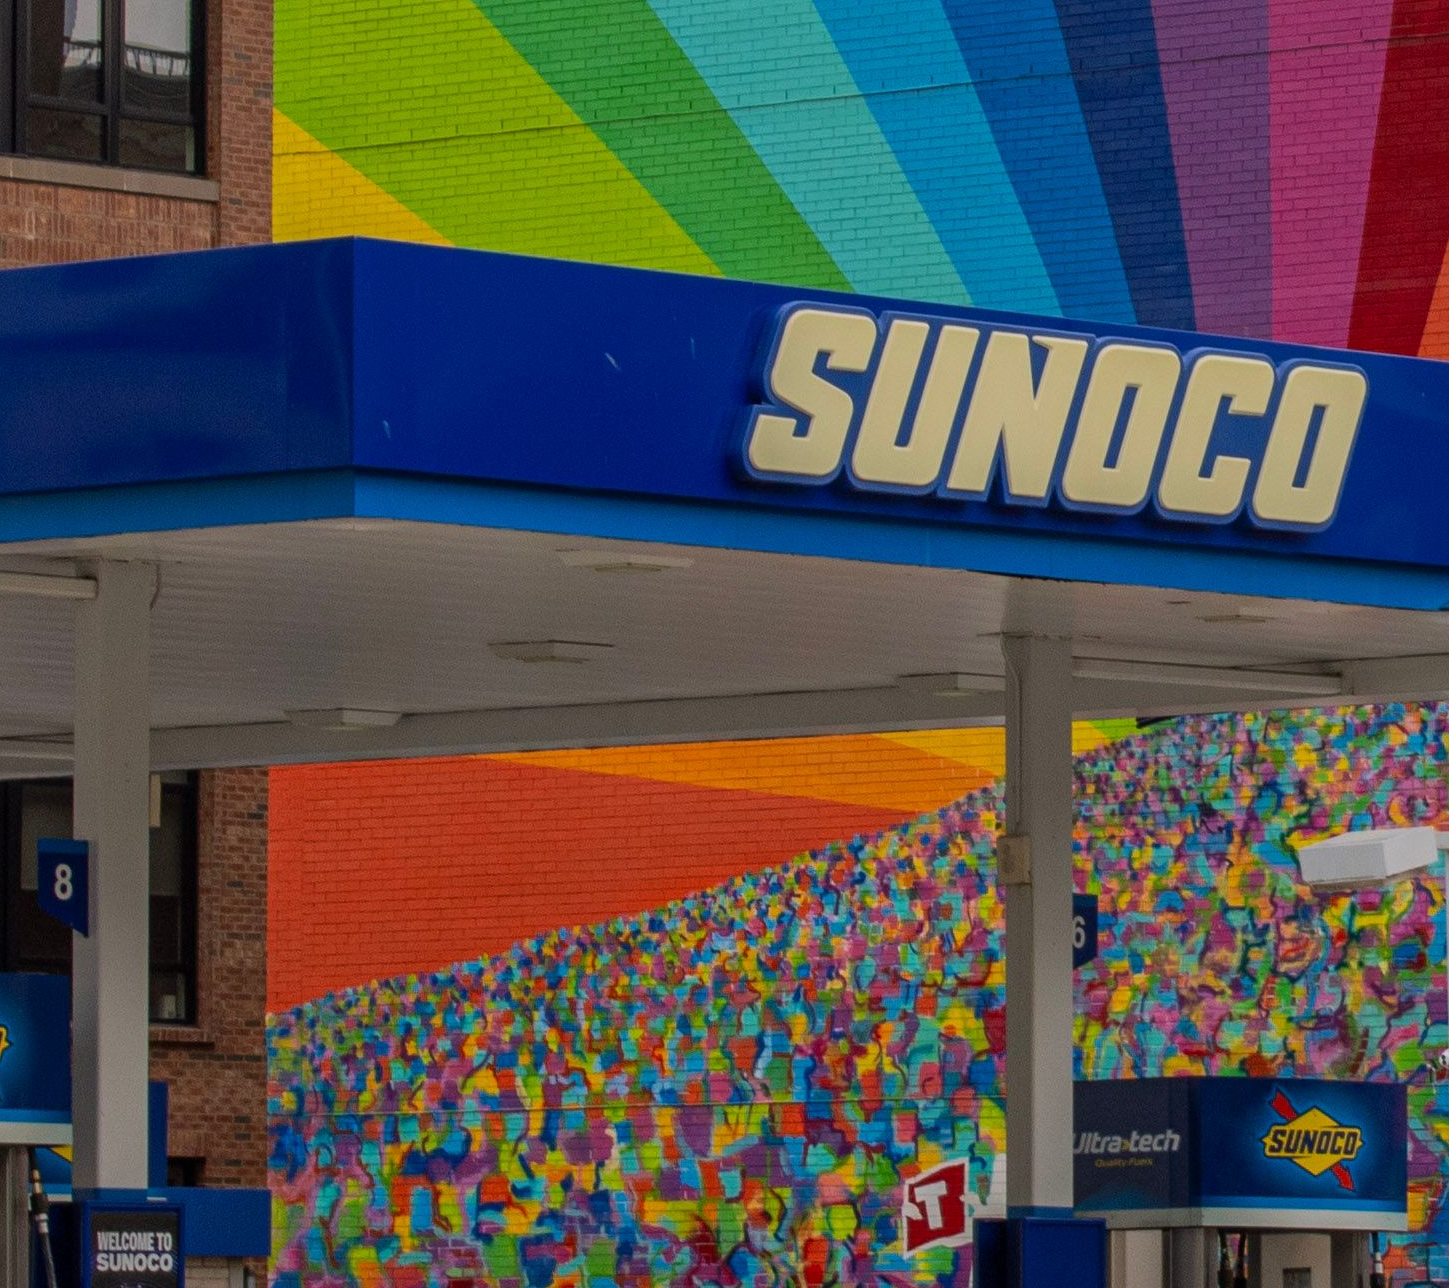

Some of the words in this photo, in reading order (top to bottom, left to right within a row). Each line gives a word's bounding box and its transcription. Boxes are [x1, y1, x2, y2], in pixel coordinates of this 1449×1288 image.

[746, 306, 1369, 526] SUNOCO
[54, 863, 73, 901] 8
[1072, 915, 1086, 949] 6
[1269, 1129, 1359, 1155] SUNOCO
[914, 1180, 948, 1231] T
[96, 1231, 154, 1252] WELCOME
[154, 1231, 173, 1251] TO
[96, 1253, 174, 1272] SUNOCO
